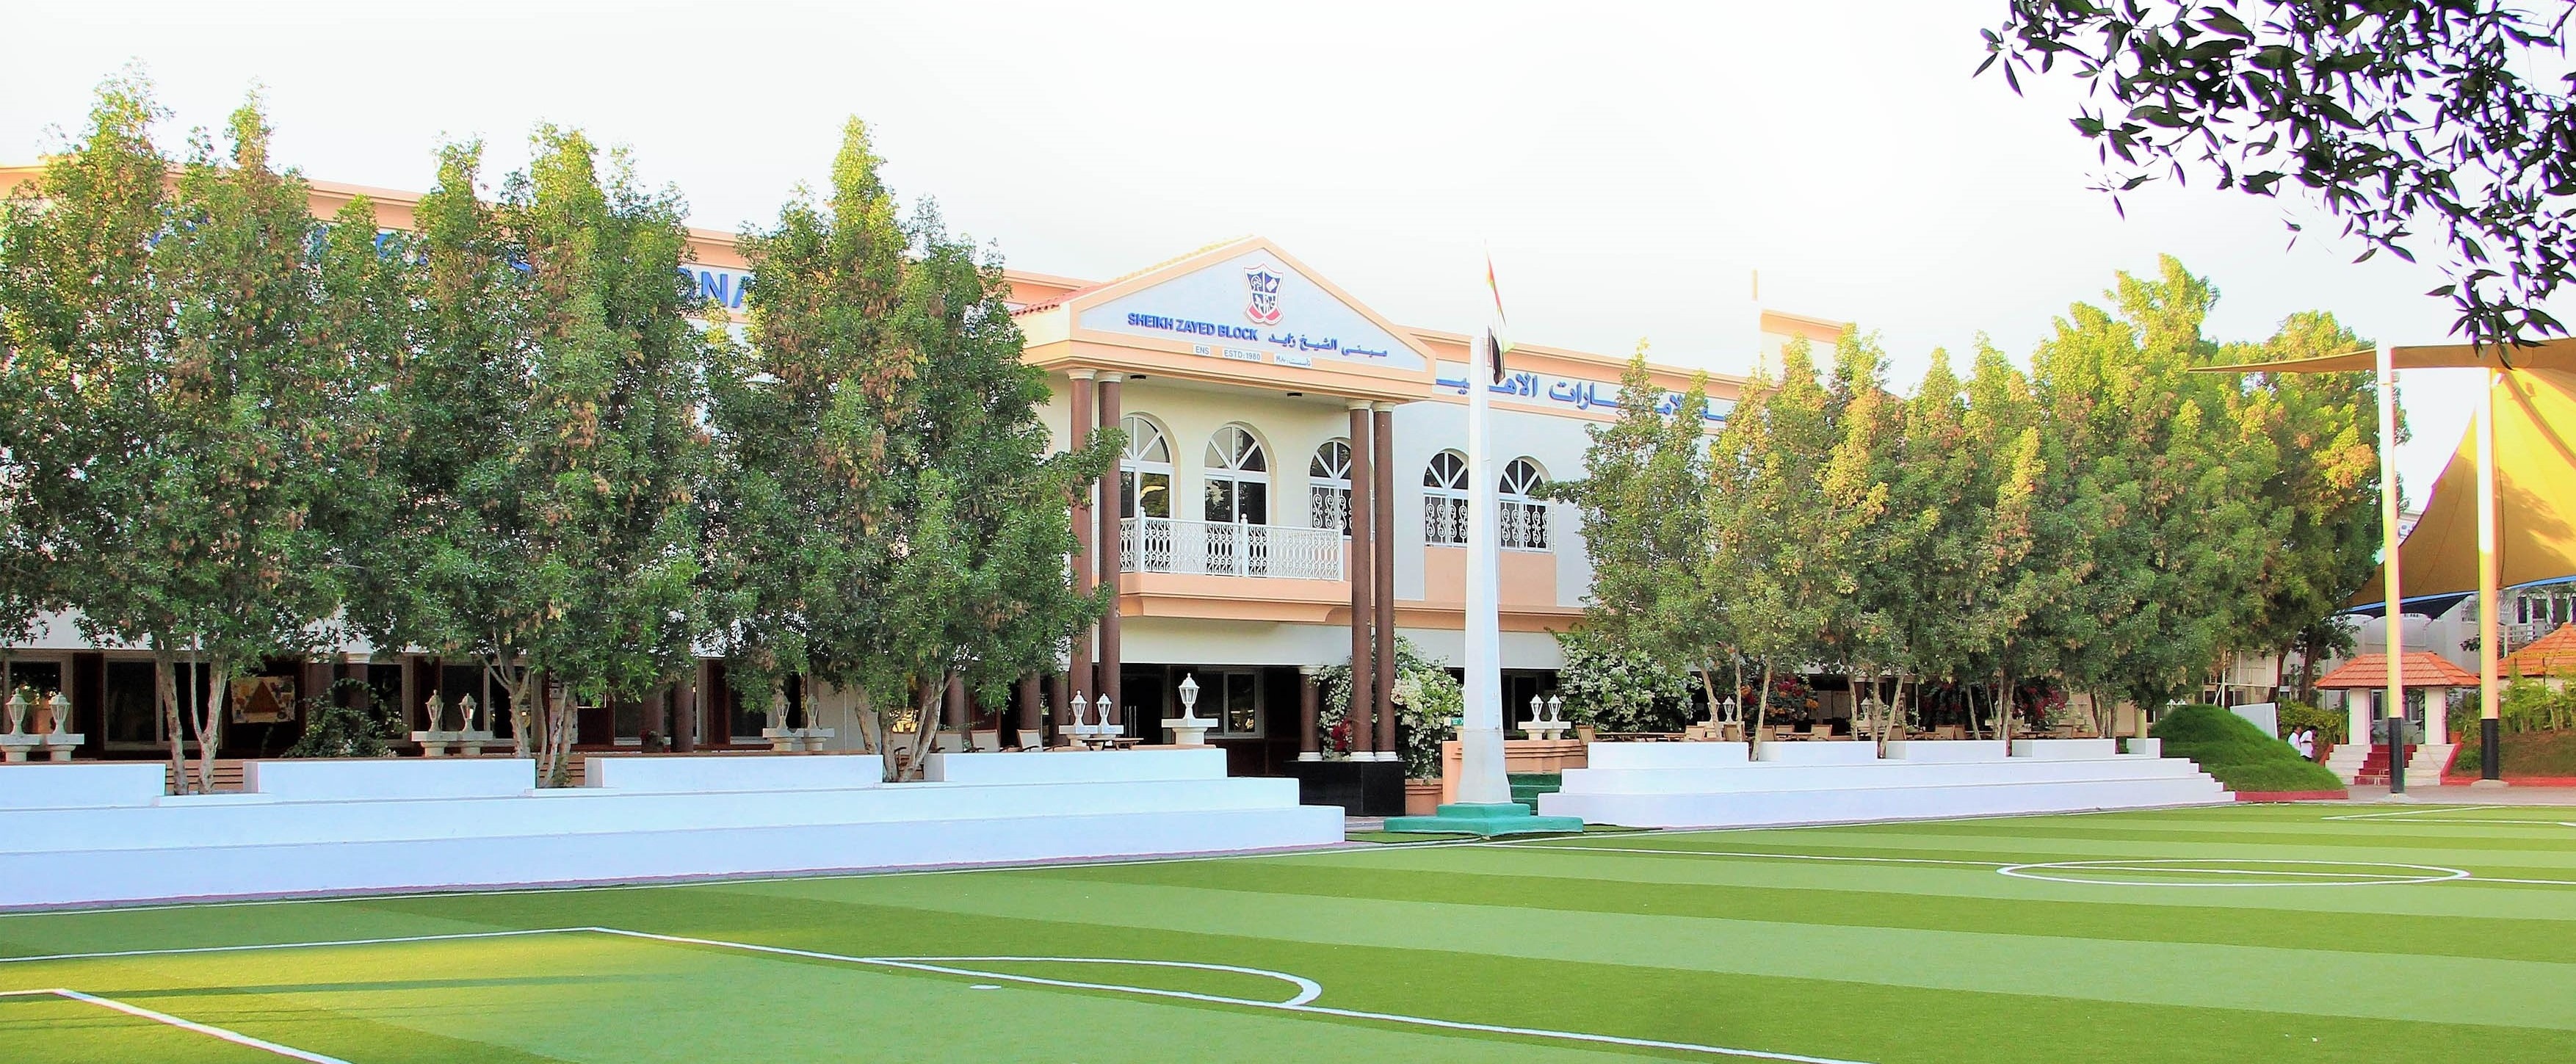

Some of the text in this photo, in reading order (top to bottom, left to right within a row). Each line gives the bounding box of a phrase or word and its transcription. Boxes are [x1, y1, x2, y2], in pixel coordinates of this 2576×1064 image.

[1128, 313, 1258, 341] SHEIKH ZAYED BLOCK
[1268, 333, 1296, 347] زايد
[1299, 334, 1337, 351] الشيخ
[1195, 346, 1209, 355] ENS
